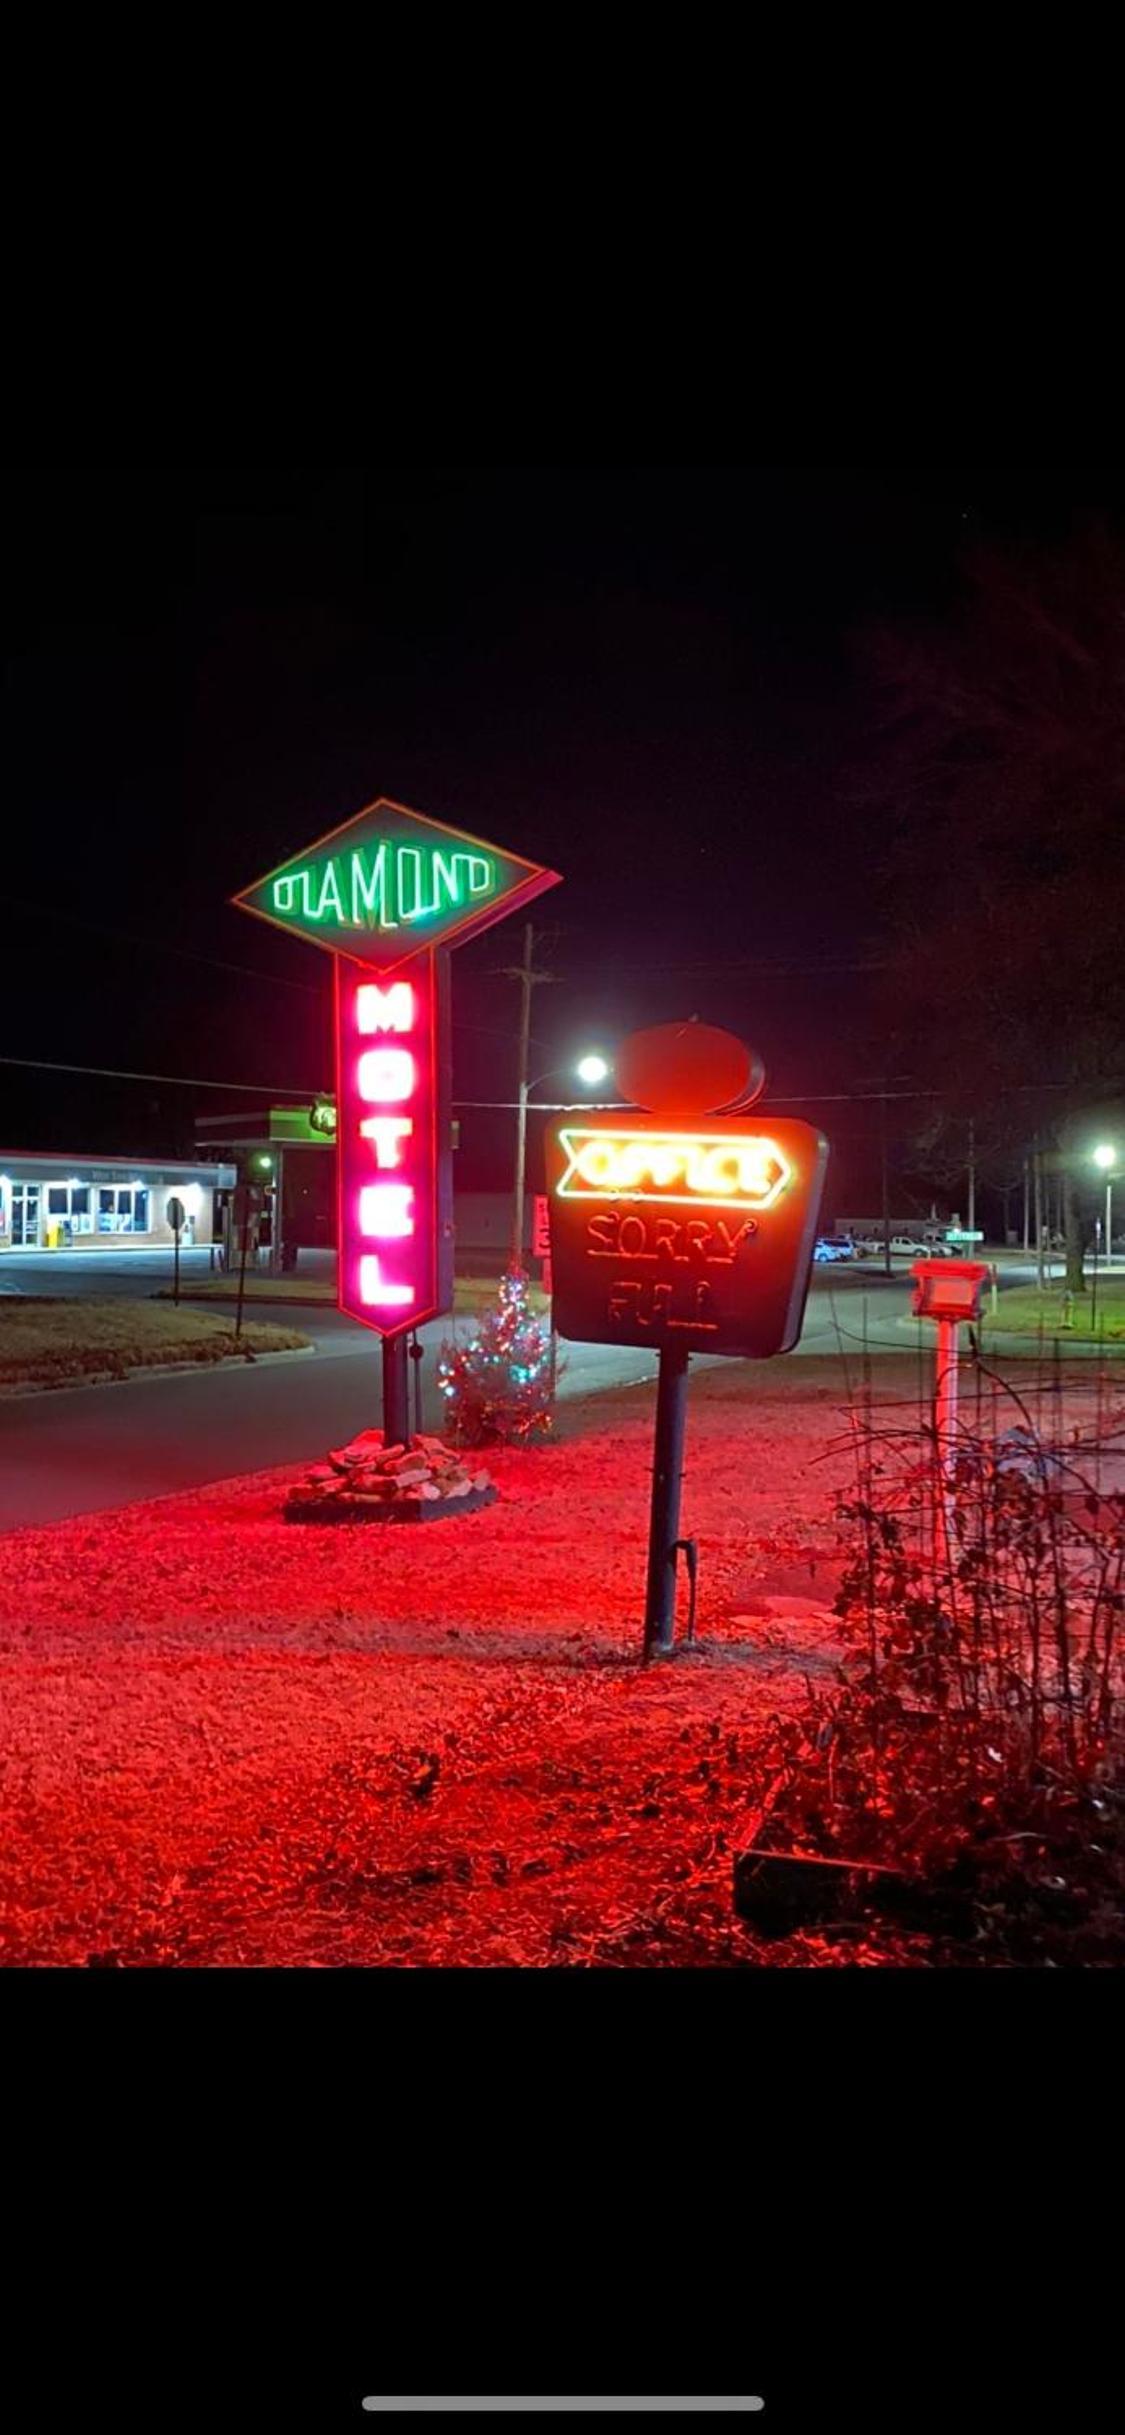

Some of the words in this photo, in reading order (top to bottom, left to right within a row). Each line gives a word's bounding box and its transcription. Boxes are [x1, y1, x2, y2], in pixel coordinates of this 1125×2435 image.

[273, 843, 492, 928] DIAMOND
[357, 983, 413, 1304] MOTEL
[577, 1140, 772, 1193] OFFICE
[587, 1211, 757, 1264] SORRY
